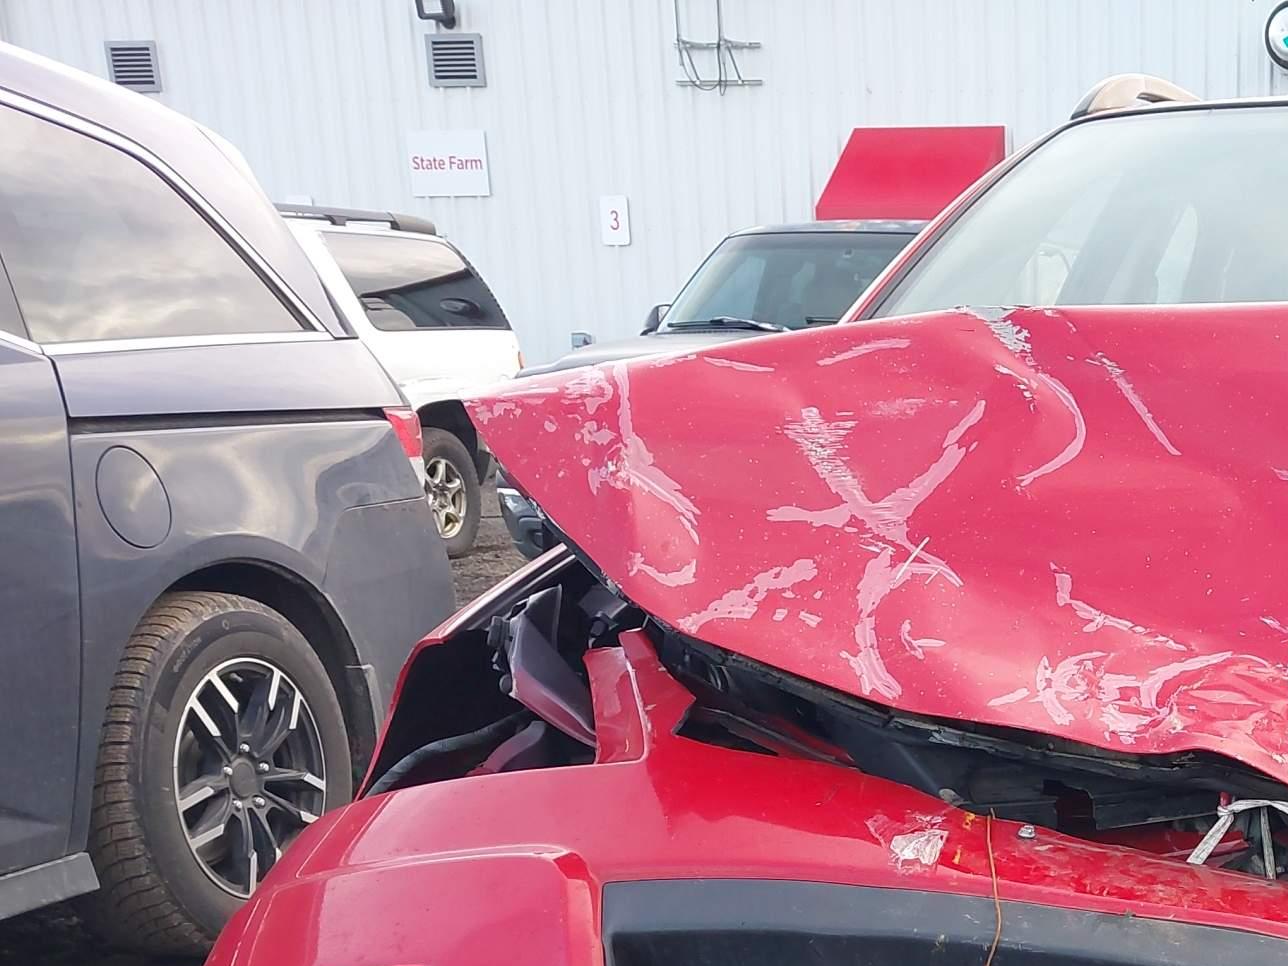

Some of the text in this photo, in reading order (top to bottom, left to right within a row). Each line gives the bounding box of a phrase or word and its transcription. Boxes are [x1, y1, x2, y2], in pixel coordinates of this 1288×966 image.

[412, 155, 483, 170] State Farm
[610, 209, 620, 231] 3
